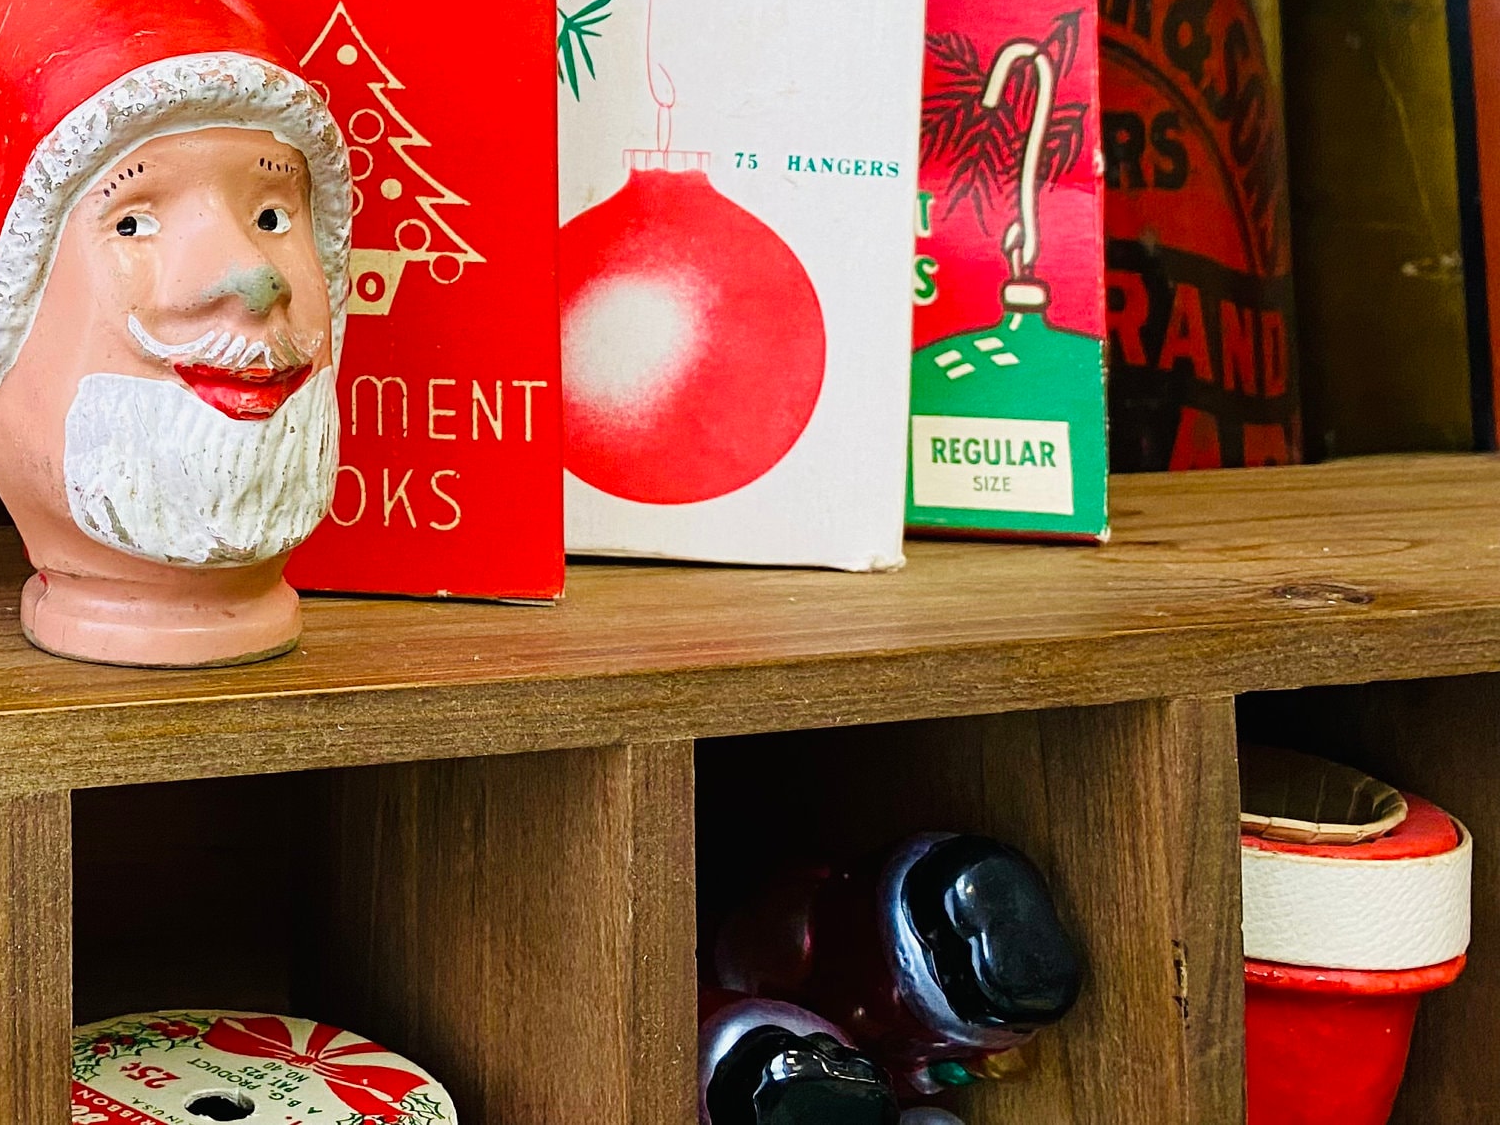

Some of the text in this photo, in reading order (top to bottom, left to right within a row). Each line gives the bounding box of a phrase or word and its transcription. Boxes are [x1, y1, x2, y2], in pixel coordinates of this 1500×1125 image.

[734, 151, 900, 178] 75 HANGERS
[930, 436, 1057, 468] REGULAR
[973, 476, 1012, 492] SIZE
[186, 1057, 263, 1091] PRODUCT
[237, 1065, 300, 1094] PAT. 925
[262, 1061, 284, 1073] 40
[307, 1106, 323, 1115] A
